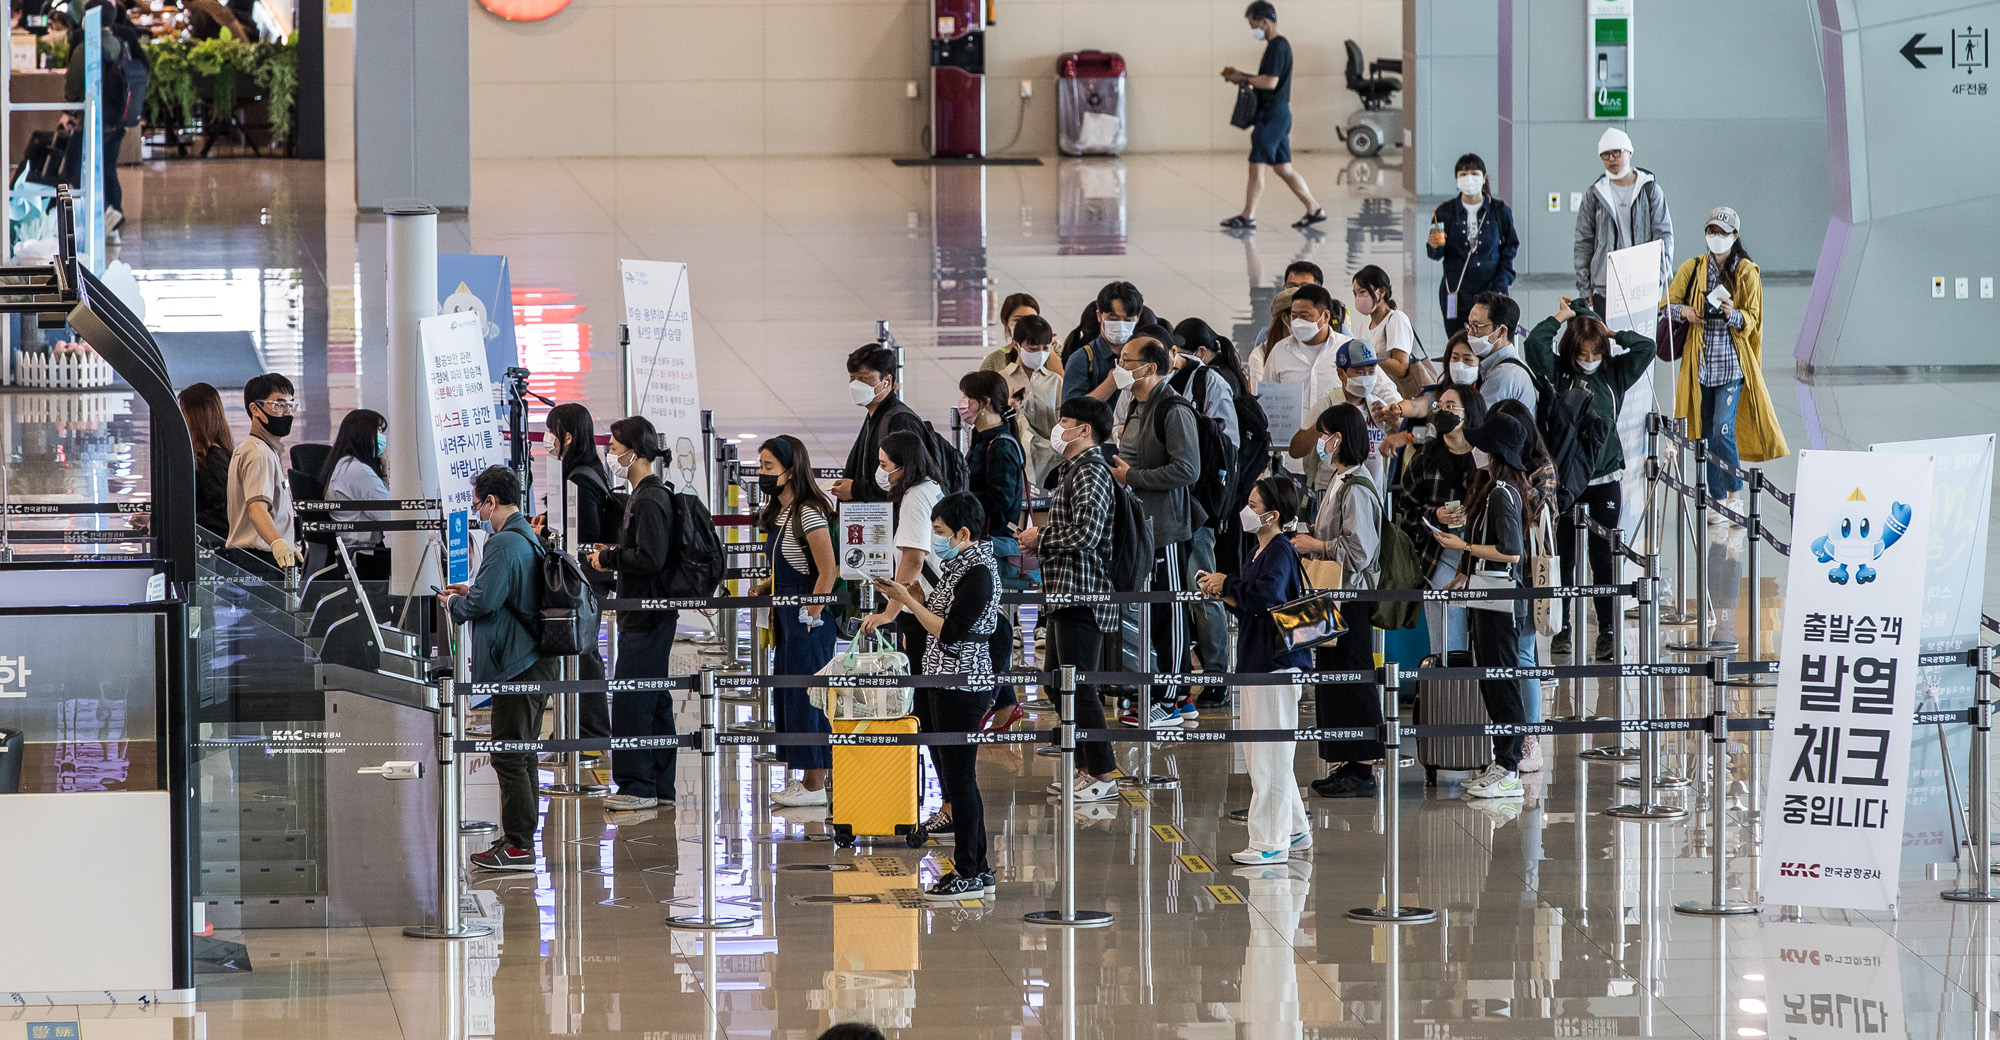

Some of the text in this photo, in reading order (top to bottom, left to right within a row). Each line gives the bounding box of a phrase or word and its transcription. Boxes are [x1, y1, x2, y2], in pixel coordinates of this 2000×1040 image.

[460, 352, 472, 364] 관련
[430, 372, 450, 385] 규정에
[464, 381, 484, 395] 위하여
[434, 406, 491, 431] 마스크를 잠깐
[440, 431, 493, 456] 내려주시기를
[450, 456, 488, 480] 바랍니다
[118, 504, 144, 512] KAC
[401, 500, 425, 510] KAC
[742, 568, 767, 578] KAC
[1176, 592, 1202, 600] KAC
[1423, 590, 1449, 599] KAC
[1554, 586, 1580, 596] KAC
[772, 596, 798, 606] KAC
[1046, 594, 1072, 602] KAC
[642, 599, 668, 608] KAC
[1804, 612, 1902, 646] 출발승객
[1920, 656, 1956, 664] 한국공항공사
[1486, 668, 1514, 678] KAC
[1622, 665, 1649, 676] KAC
[720, 678, 760, 686] 한국공항공사
[828, 676, 856, 686] KAC
[967, 675, 995, 684] KAC
[1154, 674, 1182, 684] KAC
[1292, 673, 1320, 683] KAC
[472, 684, 500, 694] KAC
[608, 680, 636, 690] KAC
[1800, 654, 1898, 715] 발열
[1920, 714, 1956, 722] 한국공항공사
[1484, 724, 1512, 735] KAC
[1622, 720, 1648, 731] KAC
[272, 730, 302, 740] KAC
[720, 735, 760, 743] 한국공항공사
[828, 734, 856, 744] KAC
[967, 732, 994, 742] KAC
[1156, 731, 1184, 741] KAC
[1294, 730, 1322, 740] KAC
[475, 742, 502, 752] KAC
[610, 738, 638, 748] KAC
[1788, 723, 1890, 786] 체크
[1783, 794, 1888, 829] 중입니다
[1780, 862, 1881, 880] KAC 한국공항공사
